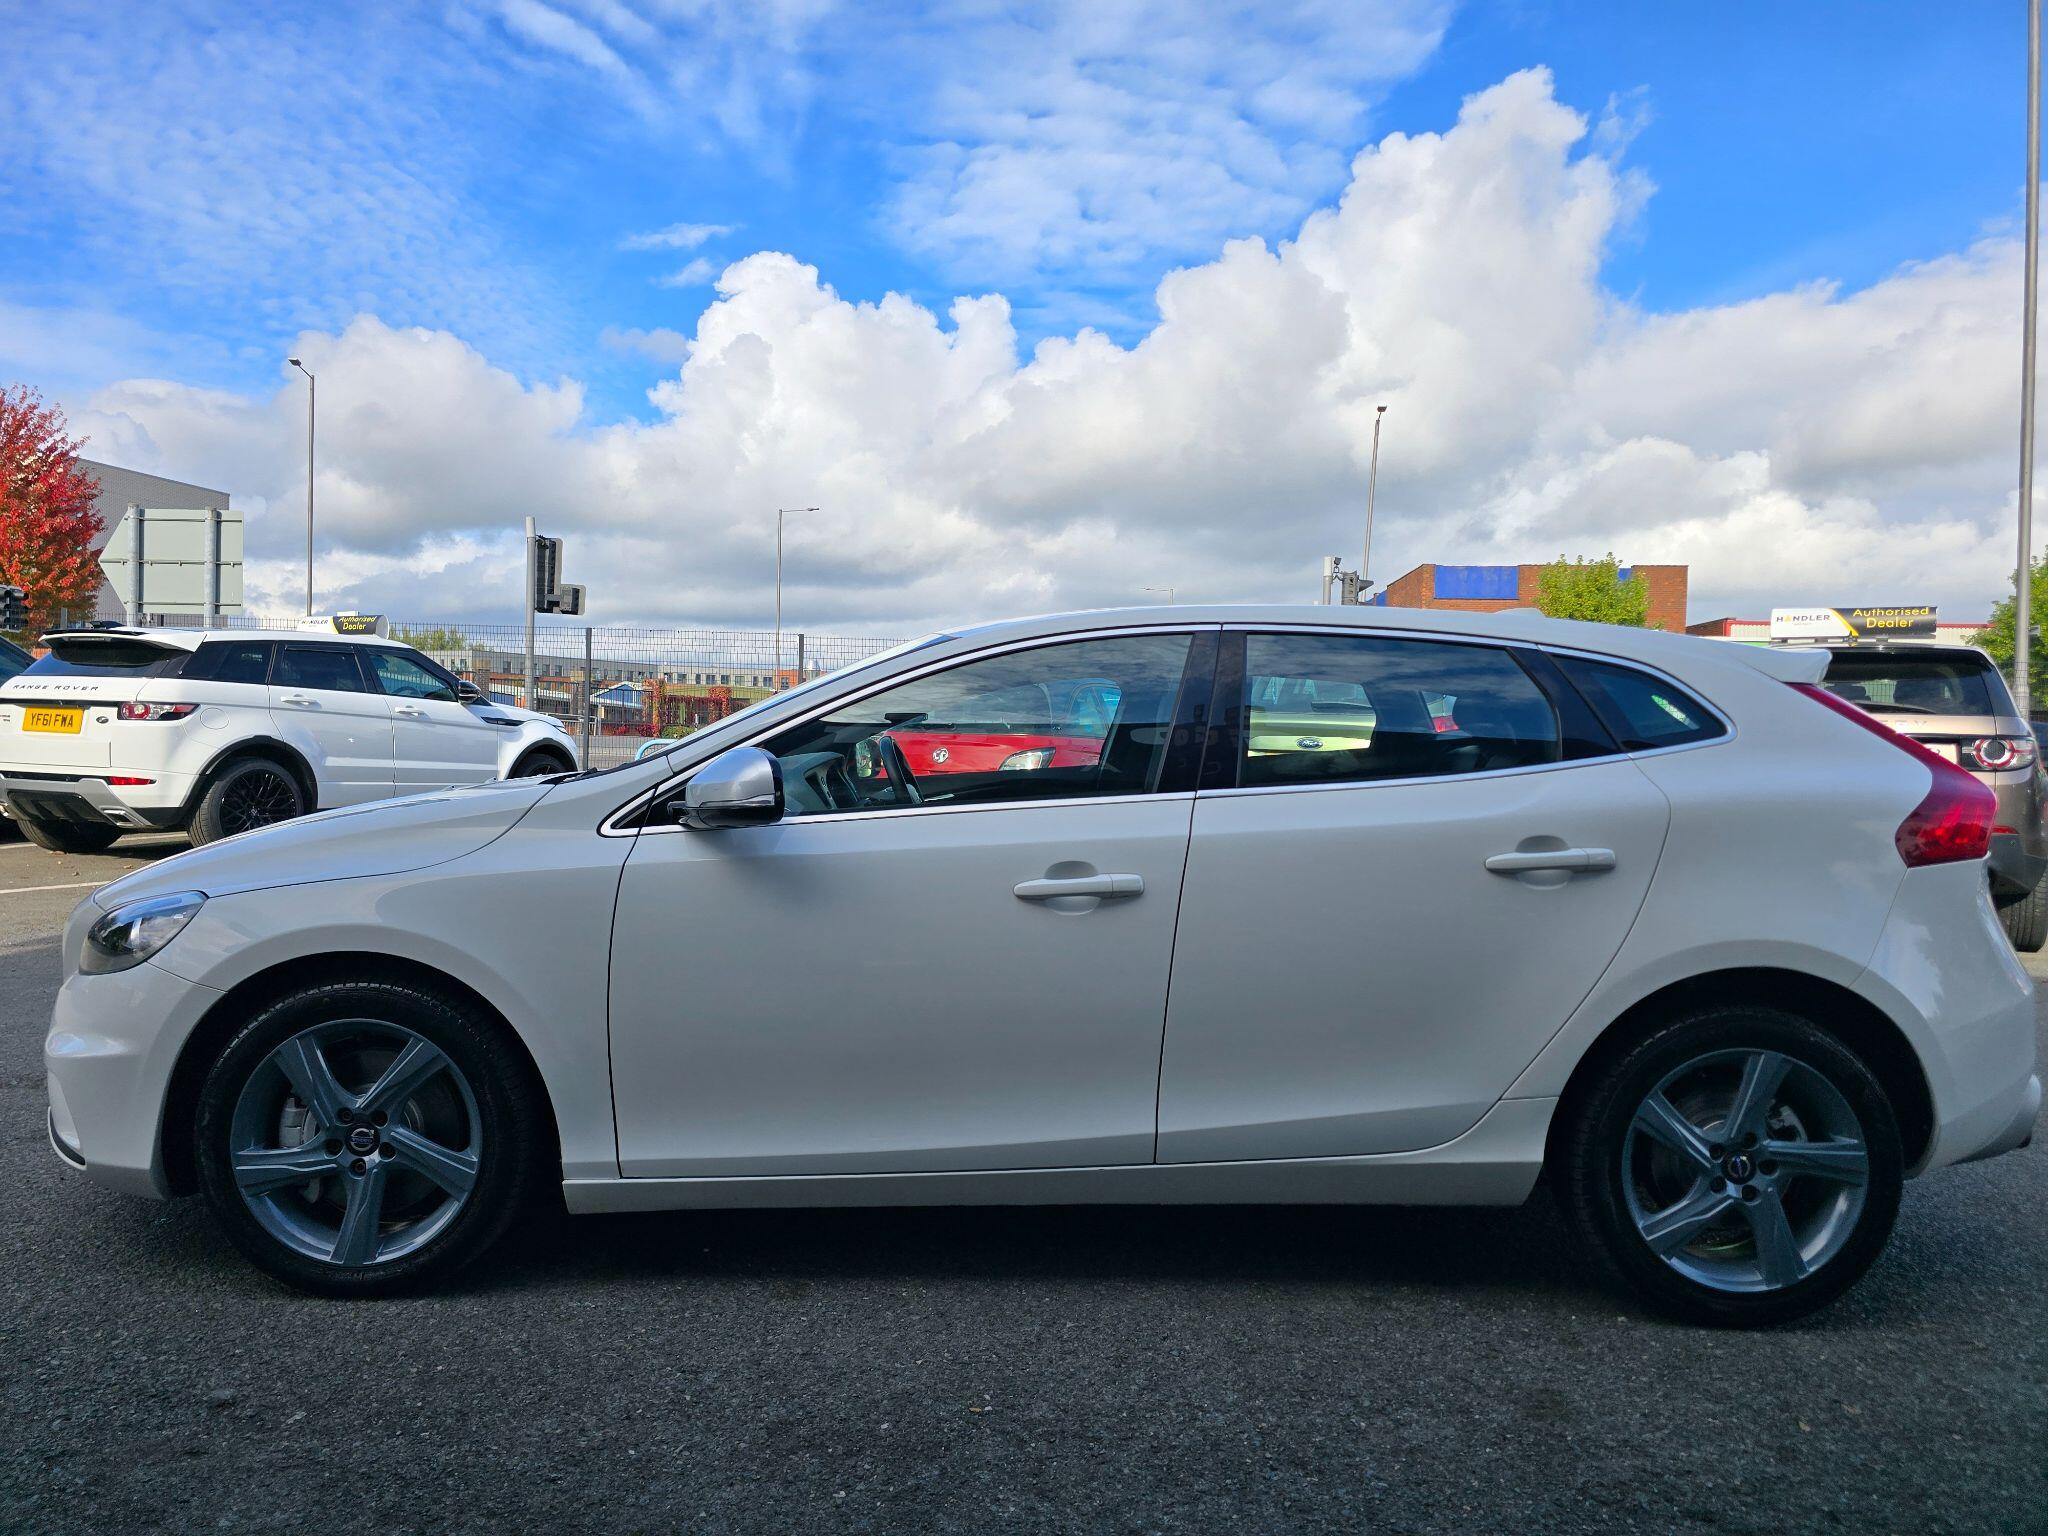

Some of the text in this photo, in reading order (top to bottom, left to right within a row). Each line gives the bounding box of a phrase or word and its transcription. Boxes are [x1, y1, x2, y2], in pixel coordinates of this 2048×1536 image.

[1853, 607, 1929, 616] Authorised
[343, 622, 366, 630] Dealer
[1866, 617, 1914, 628] Dealer
